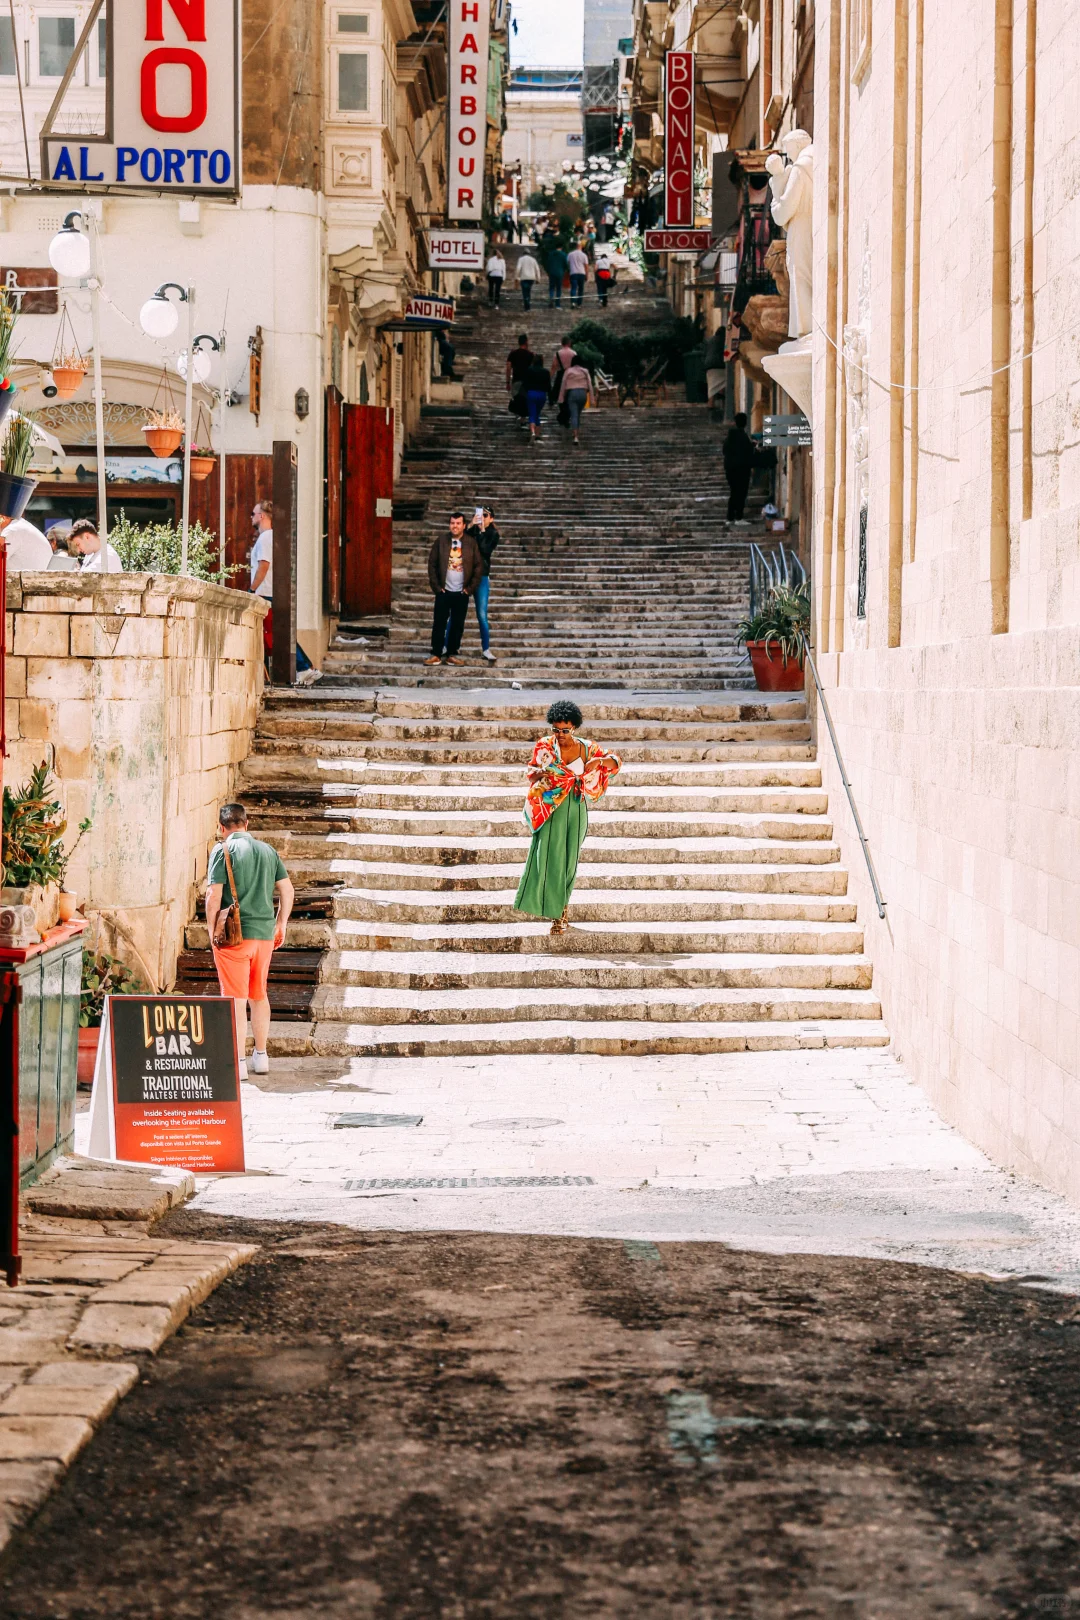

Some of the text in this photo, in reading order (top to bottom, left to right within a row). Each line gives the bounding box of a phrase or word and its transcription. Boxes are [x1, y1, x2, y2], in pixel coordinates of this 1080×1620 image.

[457, 2, 480, 209] HARBOUR
[668, 56, 692, 221] BONACI
[52, 146, 231, 184] AL PORTO
[431, 240, 481, 255] HOTEL
[155, 1034, 193, 1056] BAR
[145, 1058, 207, 1071] & RESTAURANT
[142, 1075, 212, 1091] TRADITIONAL
[143, 1090, 214, 1100] MALTESE CUISINE
[143, 1108, 215, 1118] Inside Seating available
[132, 1119, 170, 1127] overlooking
[170, 1118, 181, 1126] the
